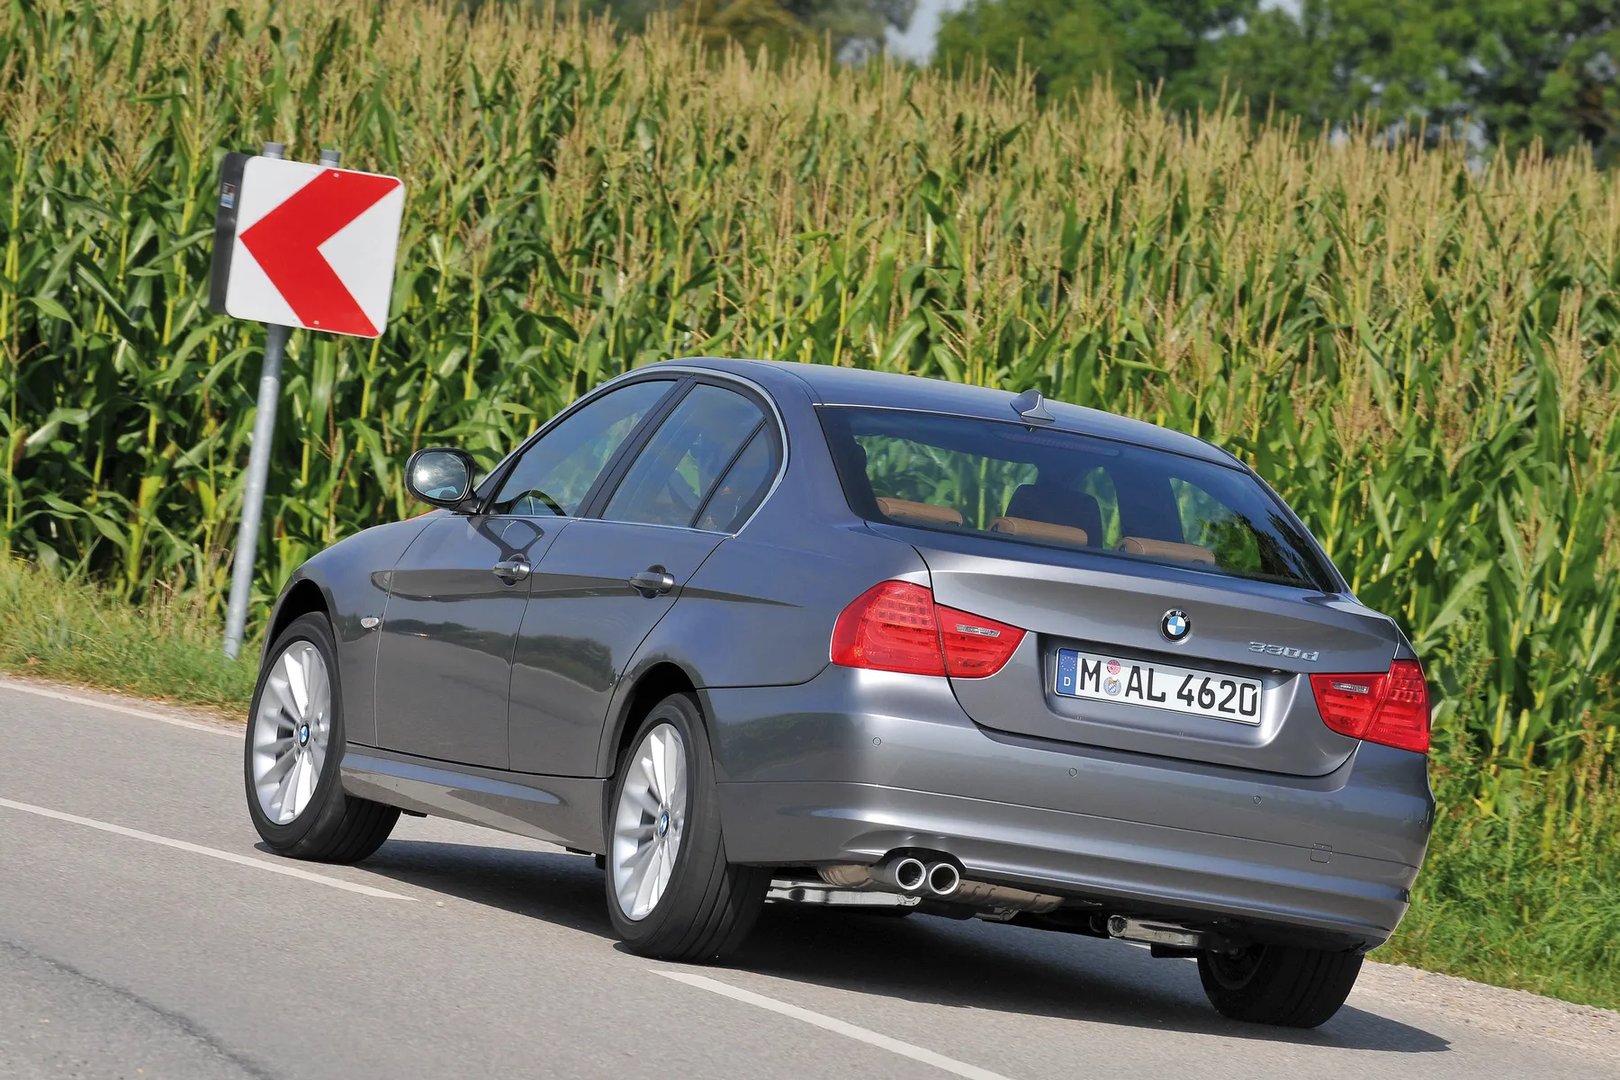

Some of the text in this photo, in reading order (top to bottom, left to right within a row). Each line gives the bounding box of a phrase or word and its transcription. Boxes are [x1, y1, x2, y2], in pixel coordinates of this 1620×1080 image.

[1248, 641, 1320, 661] 330d
[1063, 676, 1071, 687] D
[1080, 658, 1257, 717] M AL 4620
